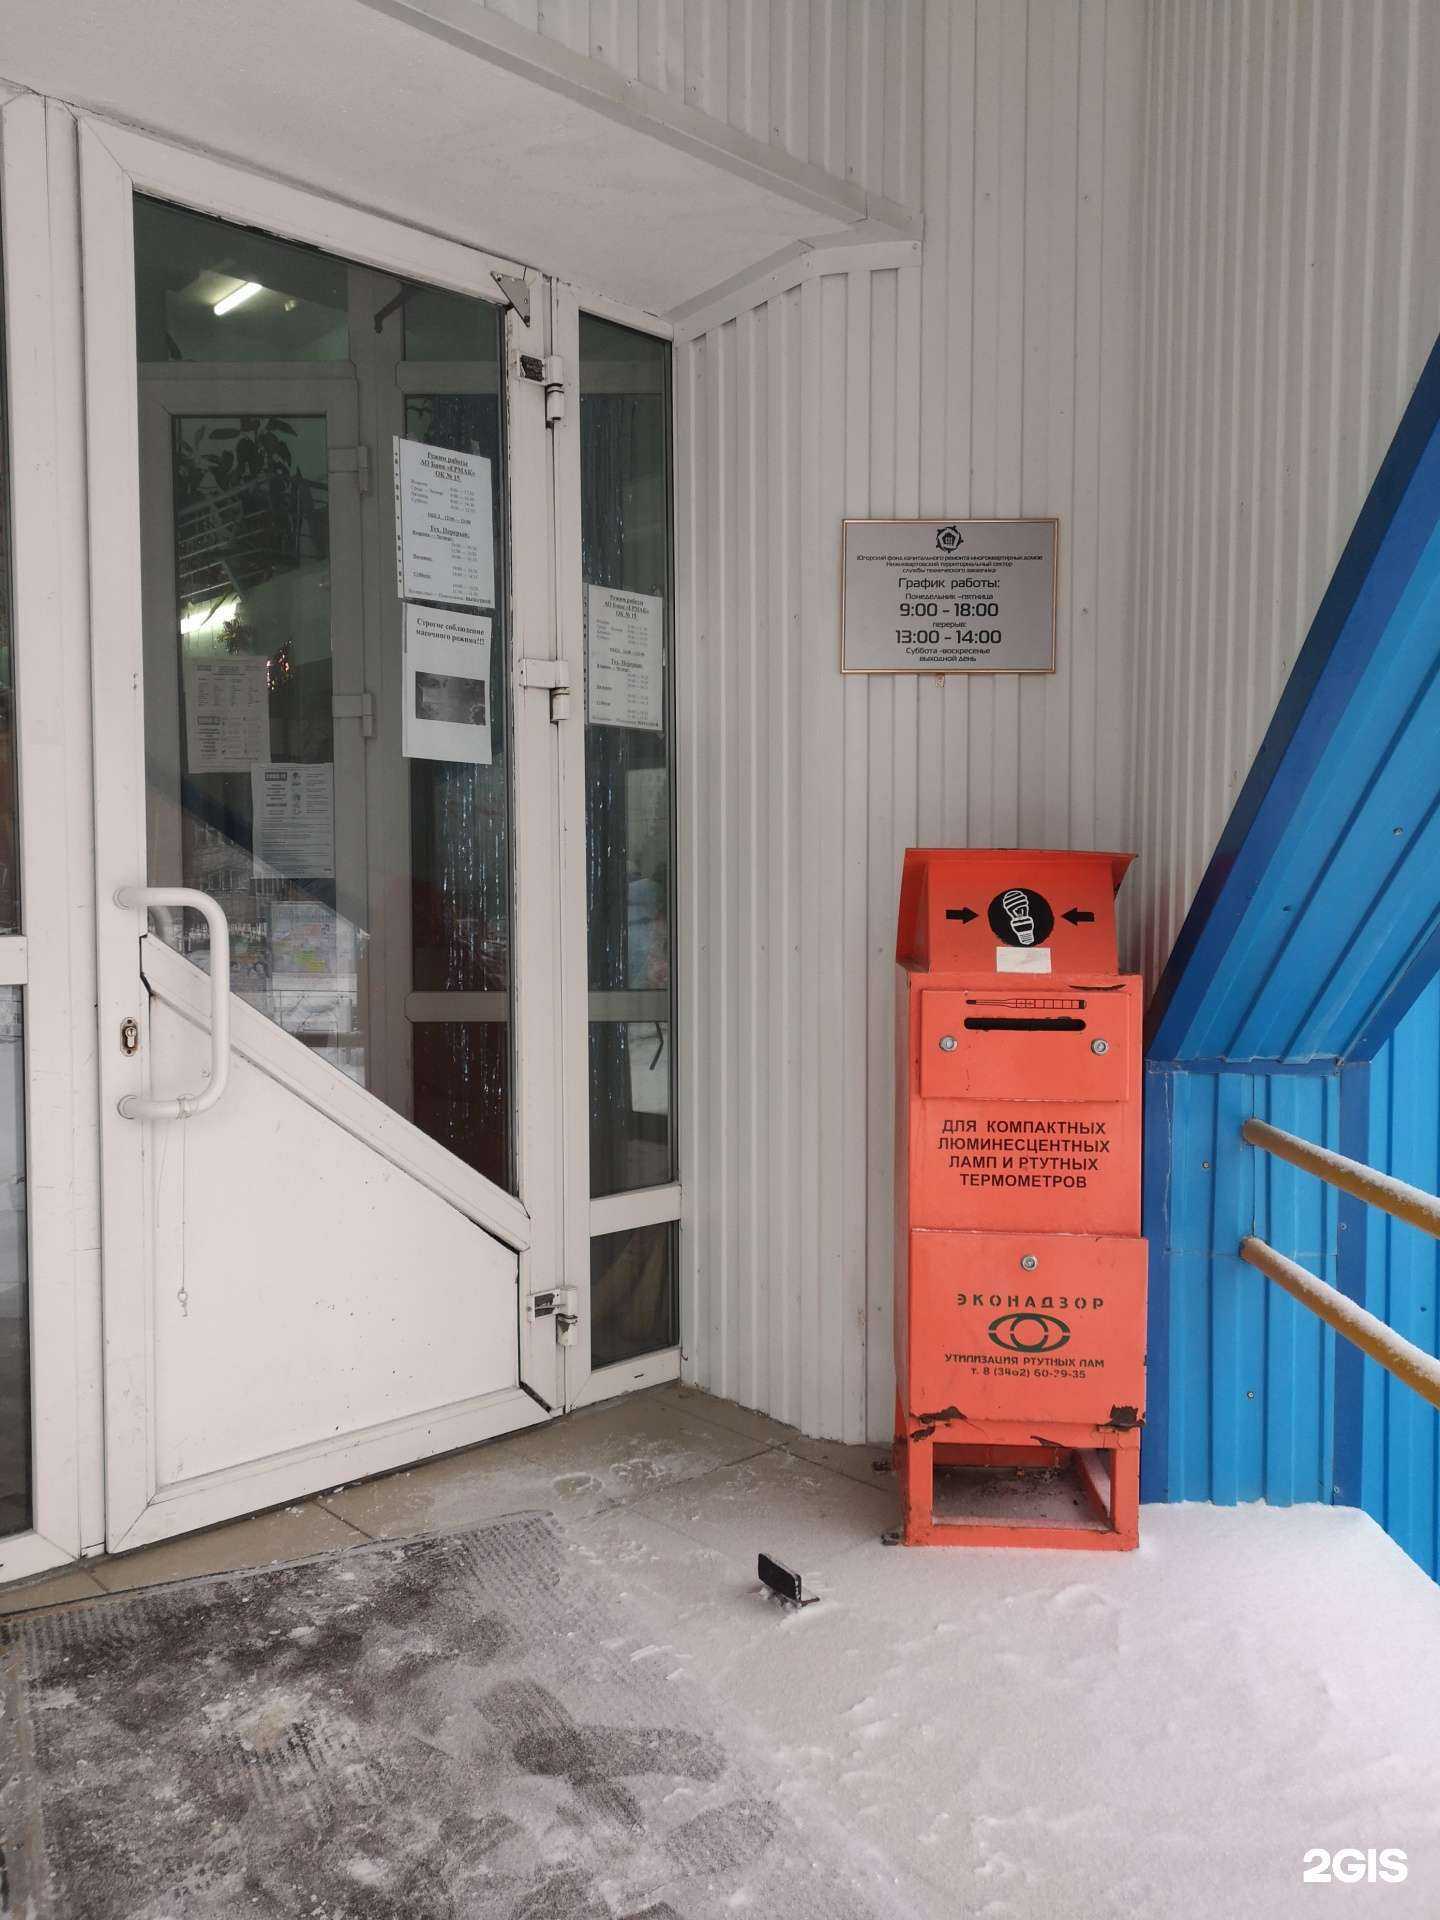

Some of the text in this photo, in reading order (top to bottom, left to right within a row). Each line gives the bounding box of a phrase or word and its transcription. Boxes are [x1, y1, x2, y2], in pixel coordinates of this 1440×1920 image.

[898, 577, 1000, 590] График работы:
[899, 602, 938, 617] 9:00
[954, 602, 998, 617] 18:00
[895, 630, 940, 644] 13:00
[955, 630, 1002, 644] 14:00
[905, 647, 938, 655] Суббота
[942, 1119, 1106, 1135] ДЛЯ КОМПАКТНЫХ
[938, 1137, 1110, 1153] ЛЮМИНЕСЦЕНТНЫХ
[949, 1156, 1098, 1171] ЛАМП И РТУТНЫХ
[960, 1173, 1087, 1188] ТЕРМОМЕТРОВ
[957, 1293, 1104, 1310] ЭКОНАДЗОР
[945, 1354, 1019, 1365] УТИЛИЗАЦИЯ
[1023, 1357, 1076, 1367] РТУТНЫХ
[983, 1367, 990, 1376] 8
